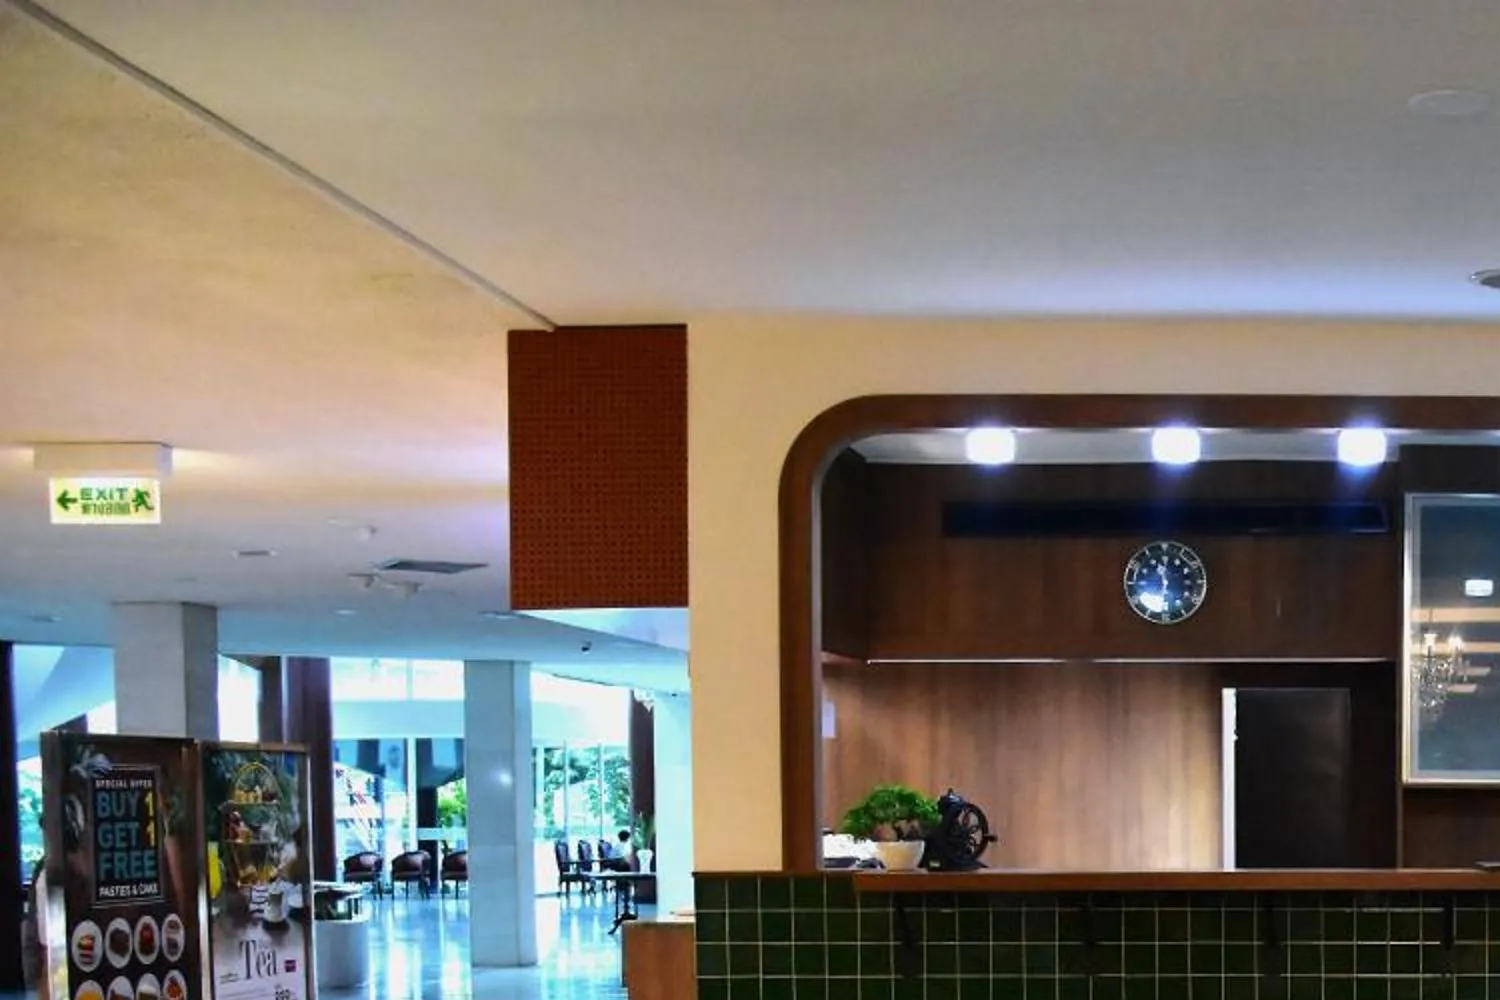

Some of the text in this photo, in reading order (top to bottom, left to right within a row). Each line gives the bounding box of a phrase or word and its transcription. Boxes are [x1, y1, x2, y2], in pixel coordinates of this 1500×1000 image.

[79, 487, 129, 501] EXIT
[95, 779, 128, 790] SPECIAL
[97, 789, 154, 819] BUY 1
[98, 820, 155, 849] GET 1
[99, 850, 157, 880] FREE
[239, 939, 278, 979] Tea
